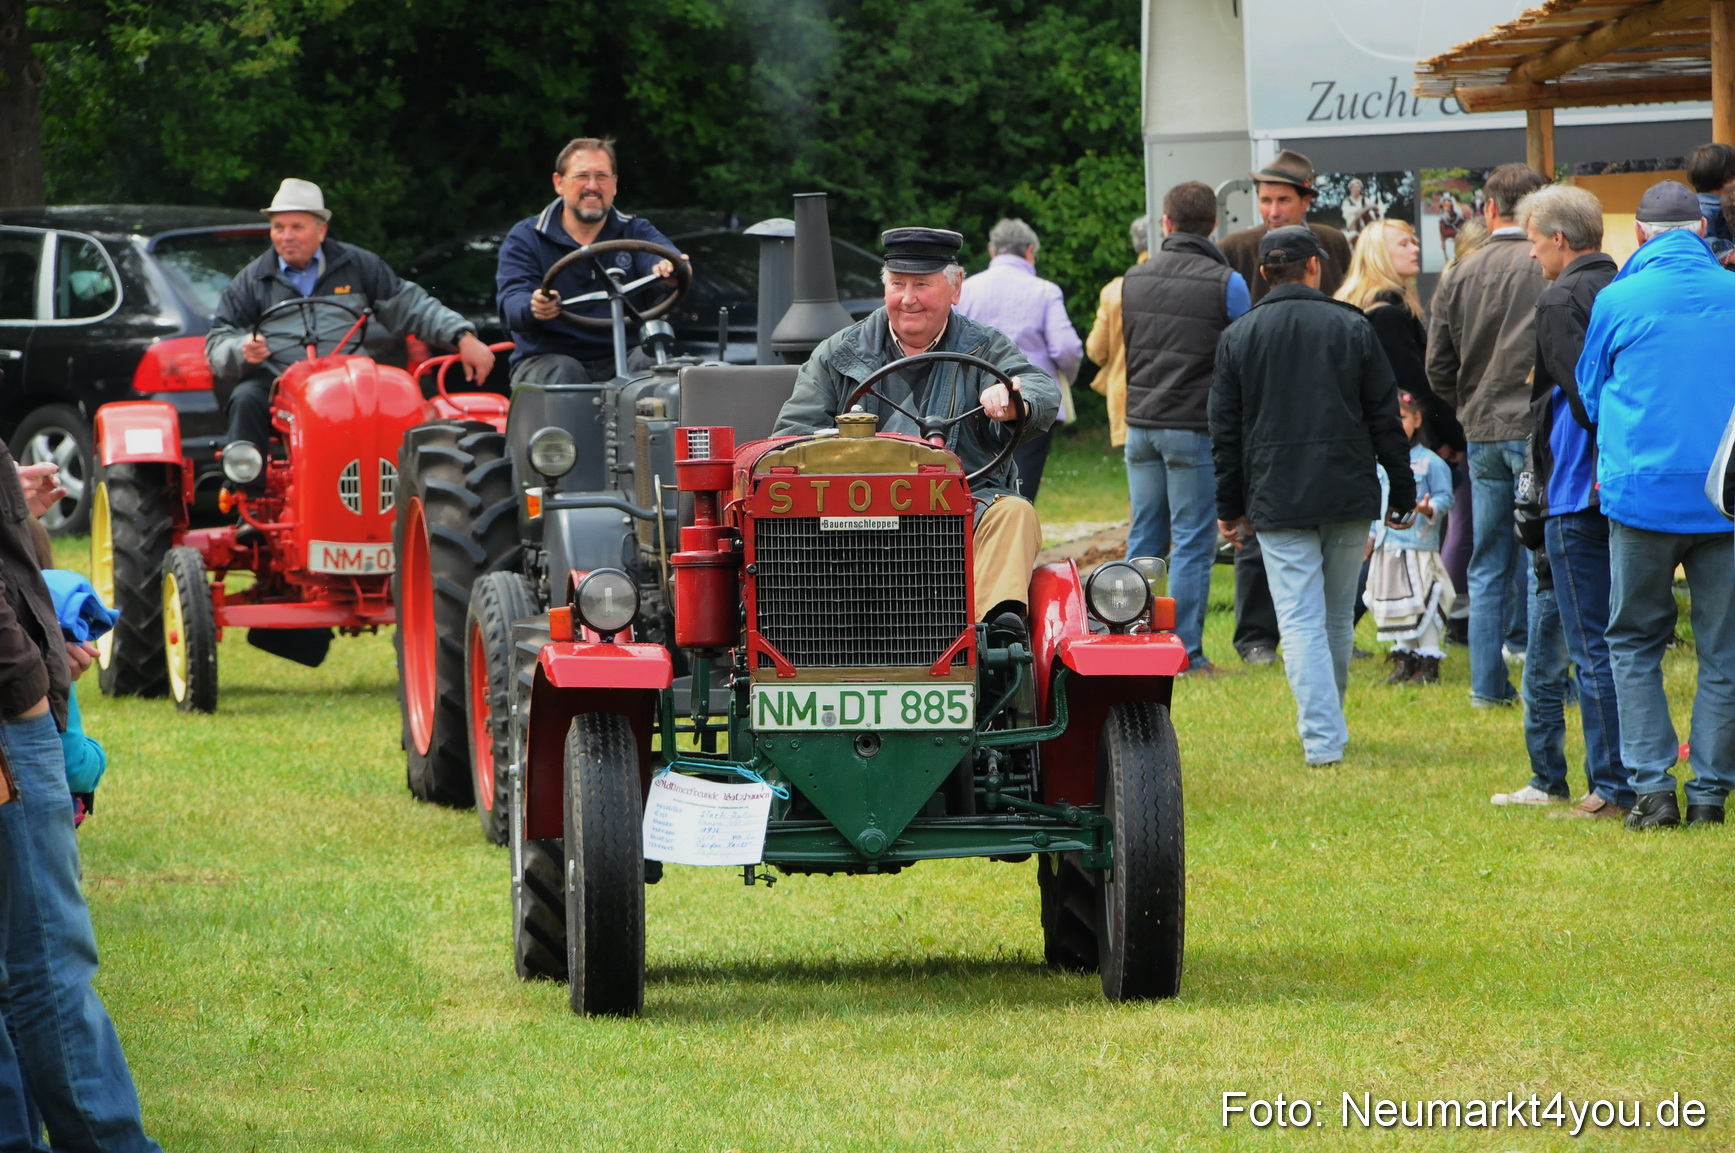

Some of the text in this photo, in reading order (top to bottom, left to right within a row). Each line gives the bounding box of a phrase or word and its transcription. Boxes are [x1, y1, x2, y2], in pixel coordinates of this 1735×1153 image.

[768, 478, 953, 514] STOCK
[822, 519, 898, 530] Bauernschlepper
[323, 546, 397, 570] NM-0
[758, 689, 969, 726] NM-DT 885
